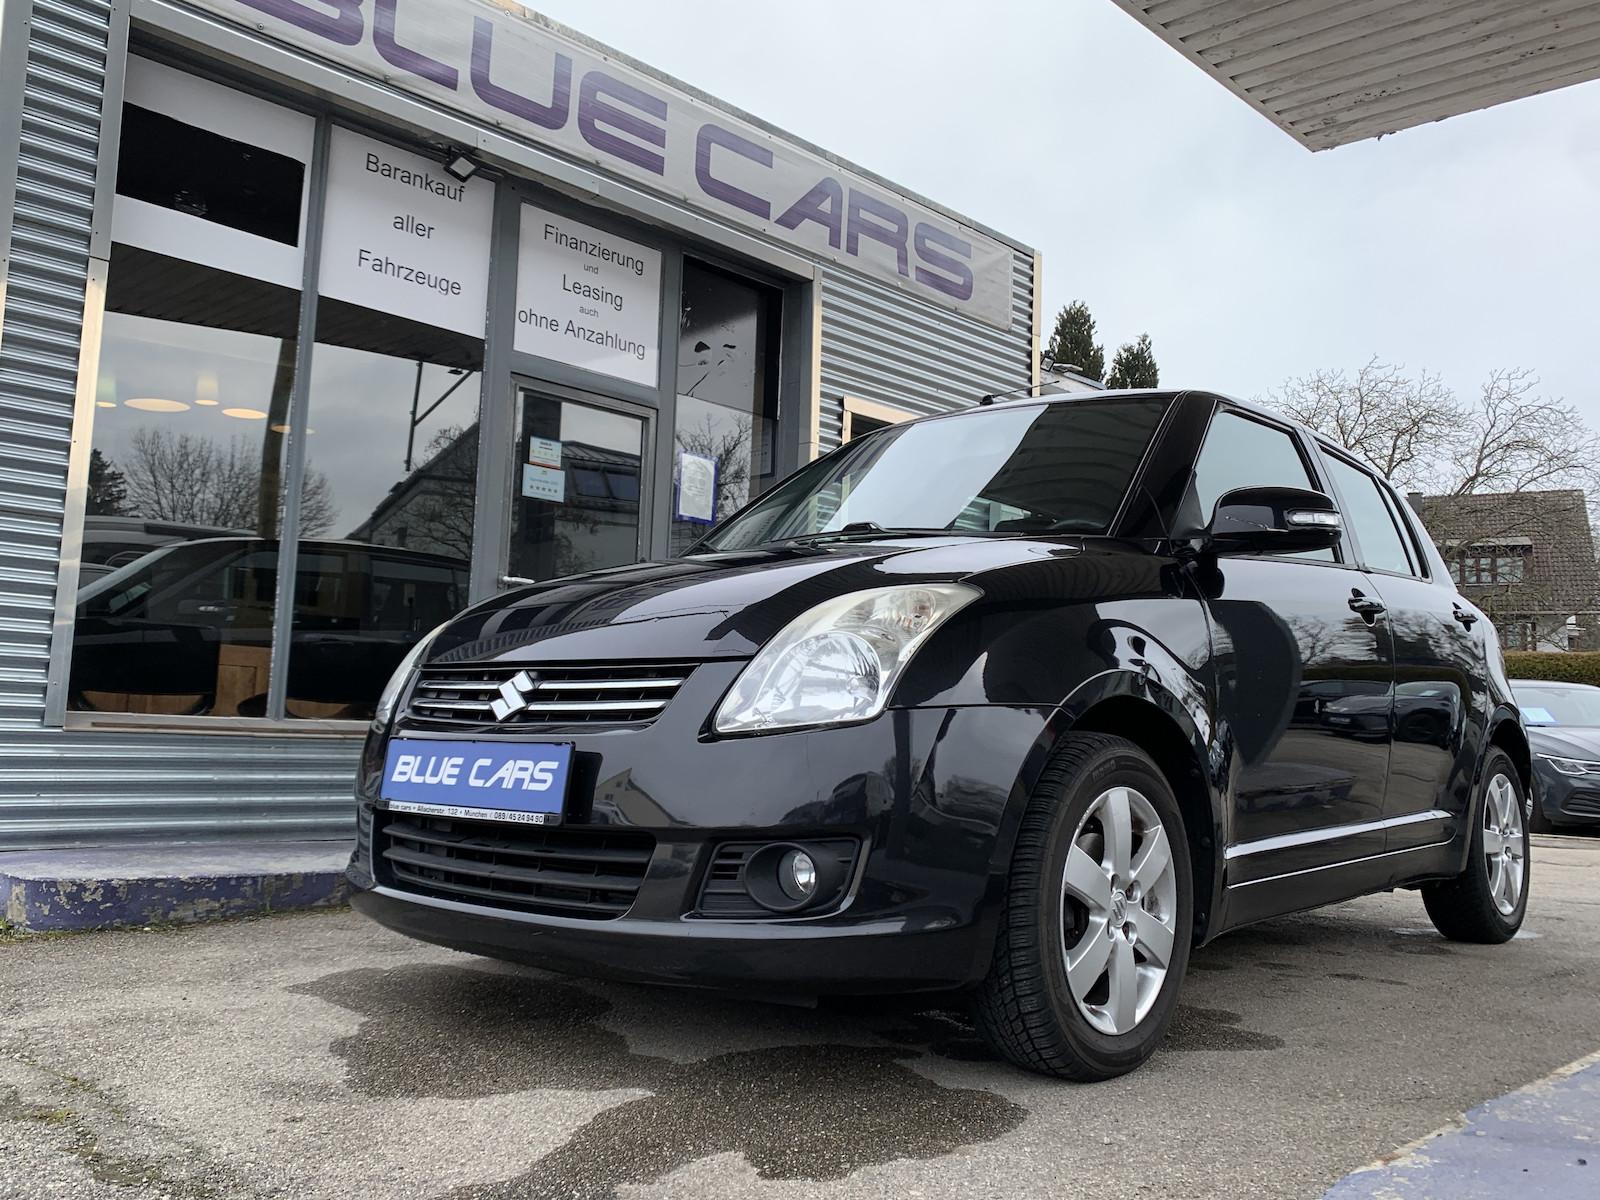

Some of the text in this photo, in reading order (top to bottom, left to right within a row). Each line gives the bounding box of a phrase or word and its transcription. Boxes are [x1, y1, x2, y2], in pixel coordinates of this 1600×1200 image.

[365, 152, 466, 202] Barankauf
[392, 214, 435, 239] aller
[695, 123, 974, 301] CARS
[543, 223, 644, 276] Finanzierung
[358, 248, 462, 296] Fahrzeuge
[583, 263, 599, 275] und
[562, 273, 623, 311] Leasing
[579, 306, 599, 318] auch
[518, 308, 645, 360] ohne Anzahlung
[391, 754, 559, 791] BLUE CARS
[447, 807, 459, 816] 132
